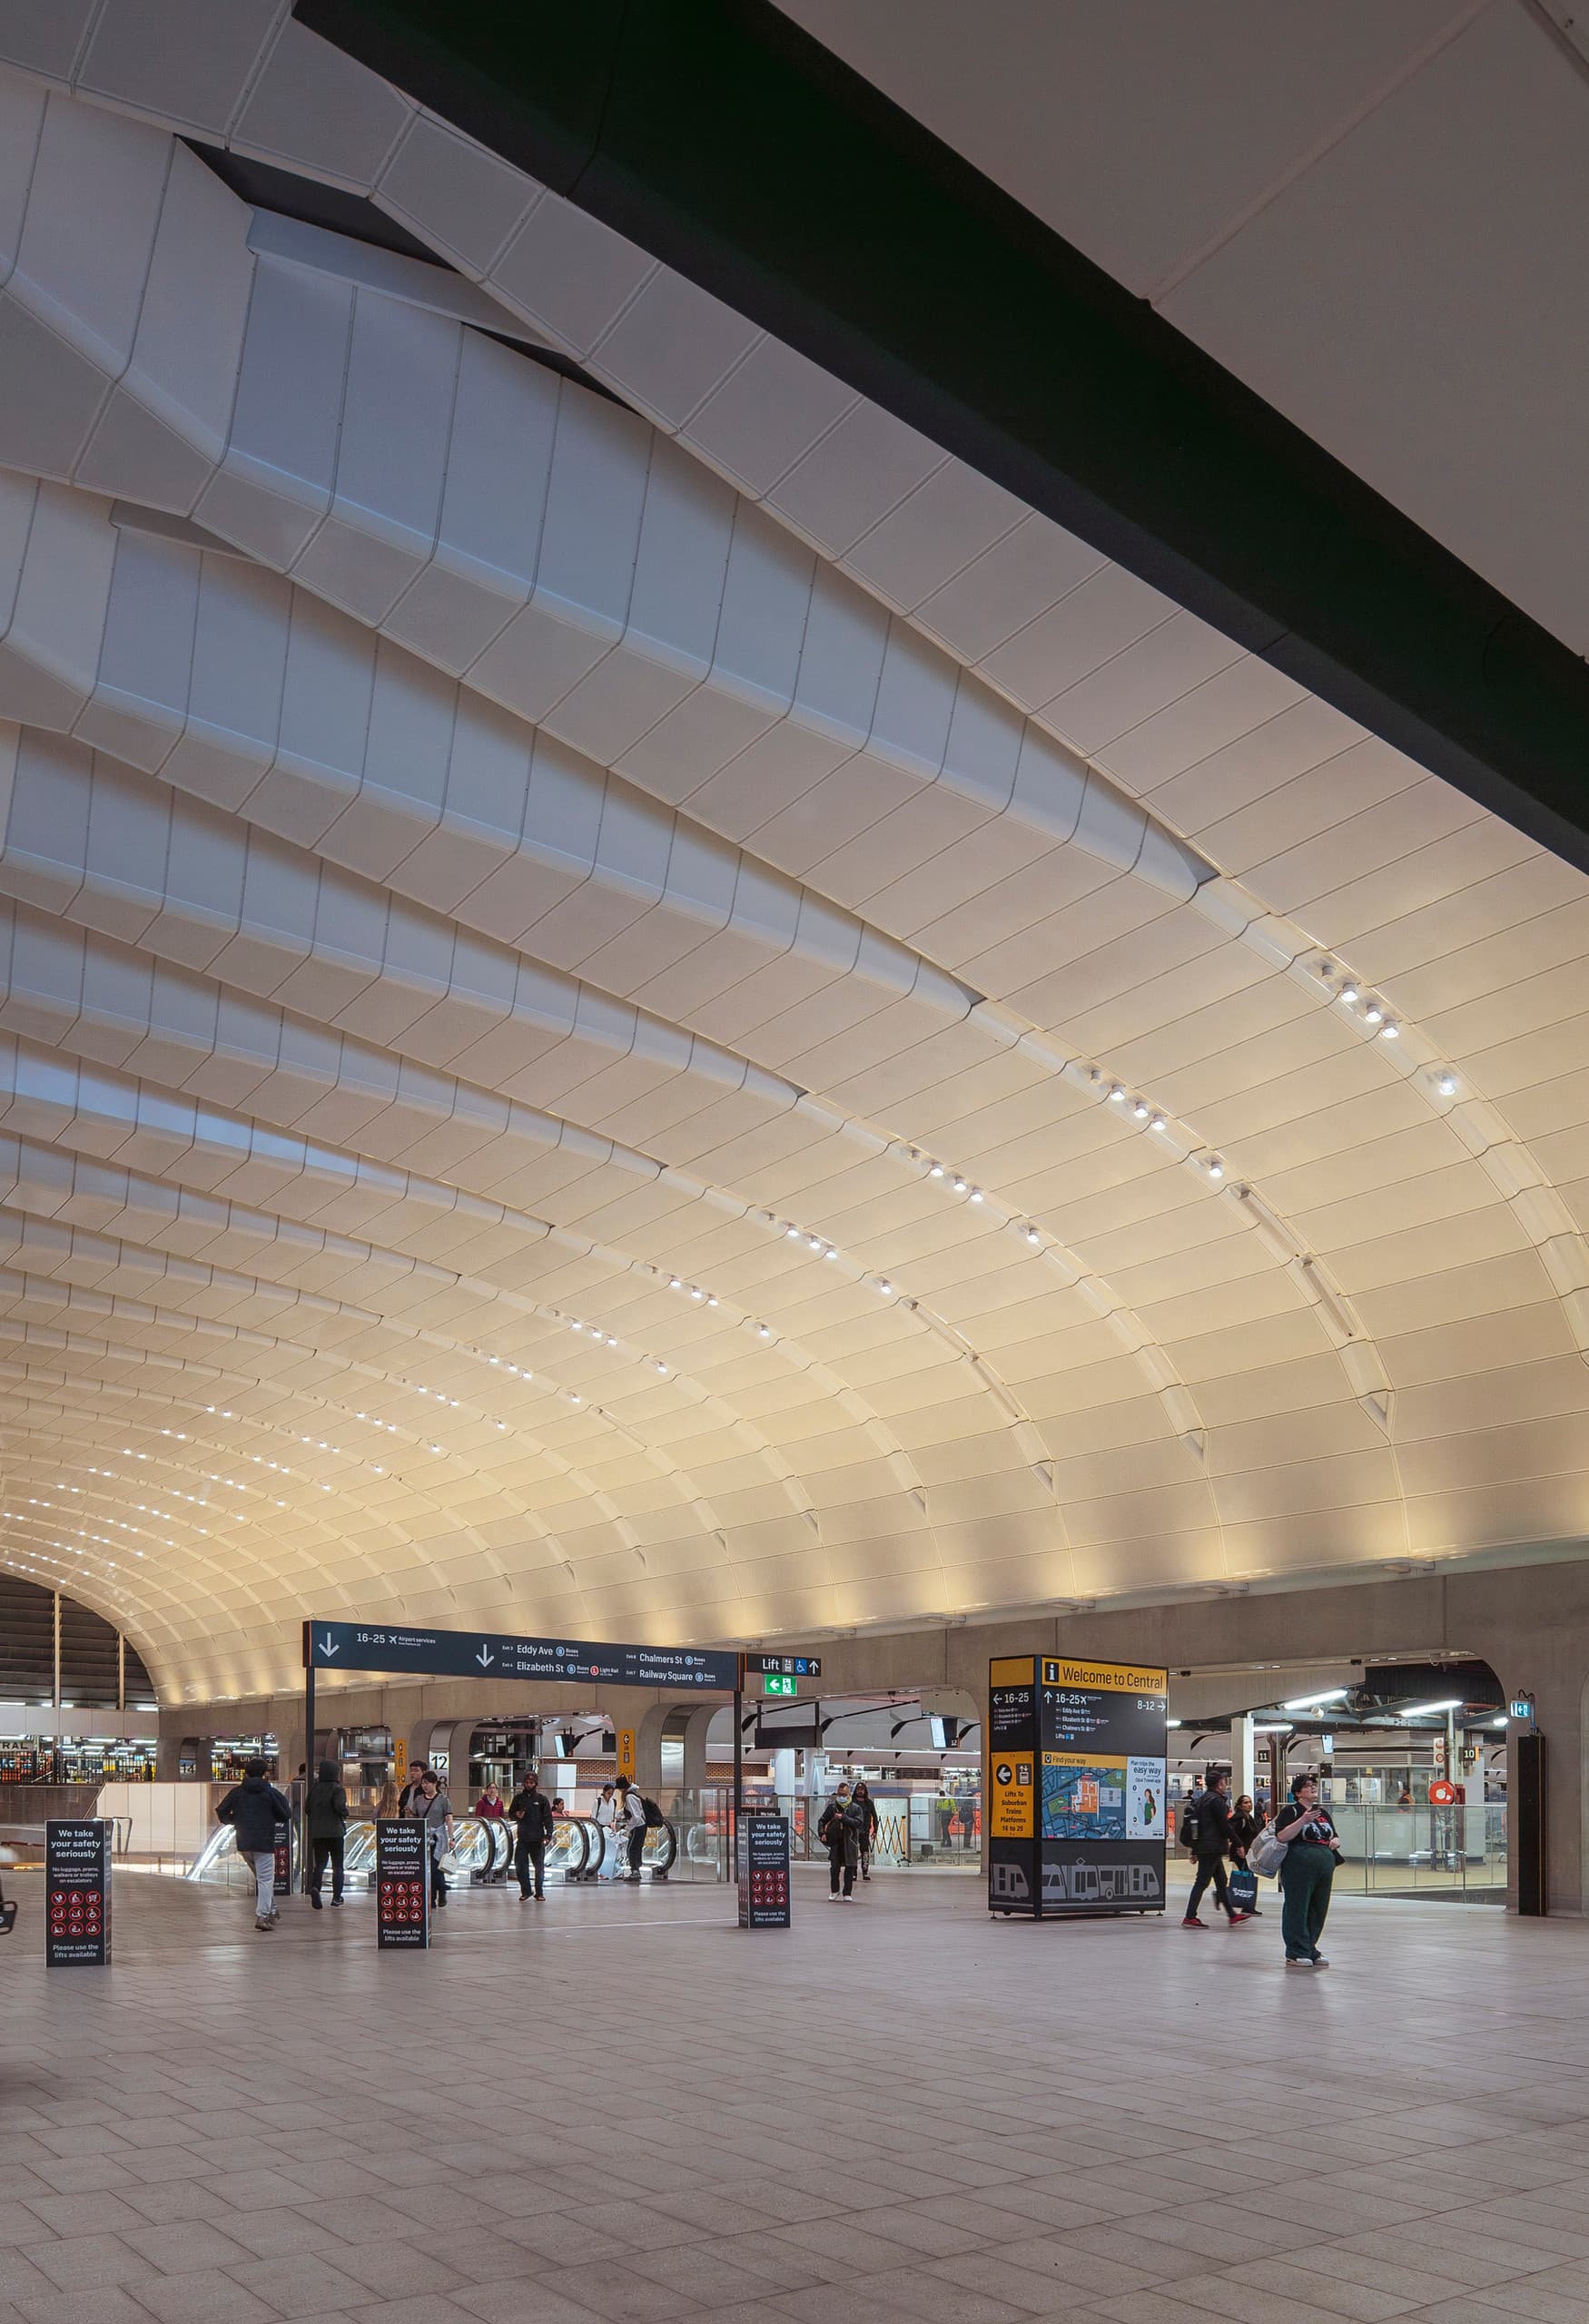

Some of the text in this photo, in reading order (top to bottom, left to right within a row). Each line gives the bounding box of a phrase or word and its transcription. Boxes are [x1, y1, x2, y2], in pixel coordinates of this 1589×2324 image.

[357, 1633, 385, 1643] 16-25
[518, 1644, 538, 1656] Eddy
[538, 1646, 553, 1655] Ave
[639, 1653, 674, 1664] Chalmers
[675, 1656, 683, 1665] St
[763, 1659, 779, 1670] Lift
[517, 1661, 555, 1672] Elizabeth
[556, 1663, 564, 1673] St
[639, 1669, 667, 1680] Railway
[667, 1671, 693, 1681] Square
[1062, 1667, 1111, 1684] Welcome
[1114, 1673, 1124, 1685] to
[1127, 1673, 1162, 1689] Central
[1004, 1692, 1029, 1703] 16-25
[1055, 1693, 1081, 1705] 16-25
[1137, 1699, 1155, 1710] 8-12
[1464, 1750, 1475, 1758] 10
[182, 1763, 194, 1774] 14
[431, 1756, 448, 1770] 12
[1134, 1767, 1161, 1776] easy way
[58, 1829, 94, 1837] We take
[51, 1839, 101, 1849] your safety
[399, 1836, 421, 1844] safety
[55, 1850, 96, 1858] seriously
[384, 1845, 418, 1853] seriously
